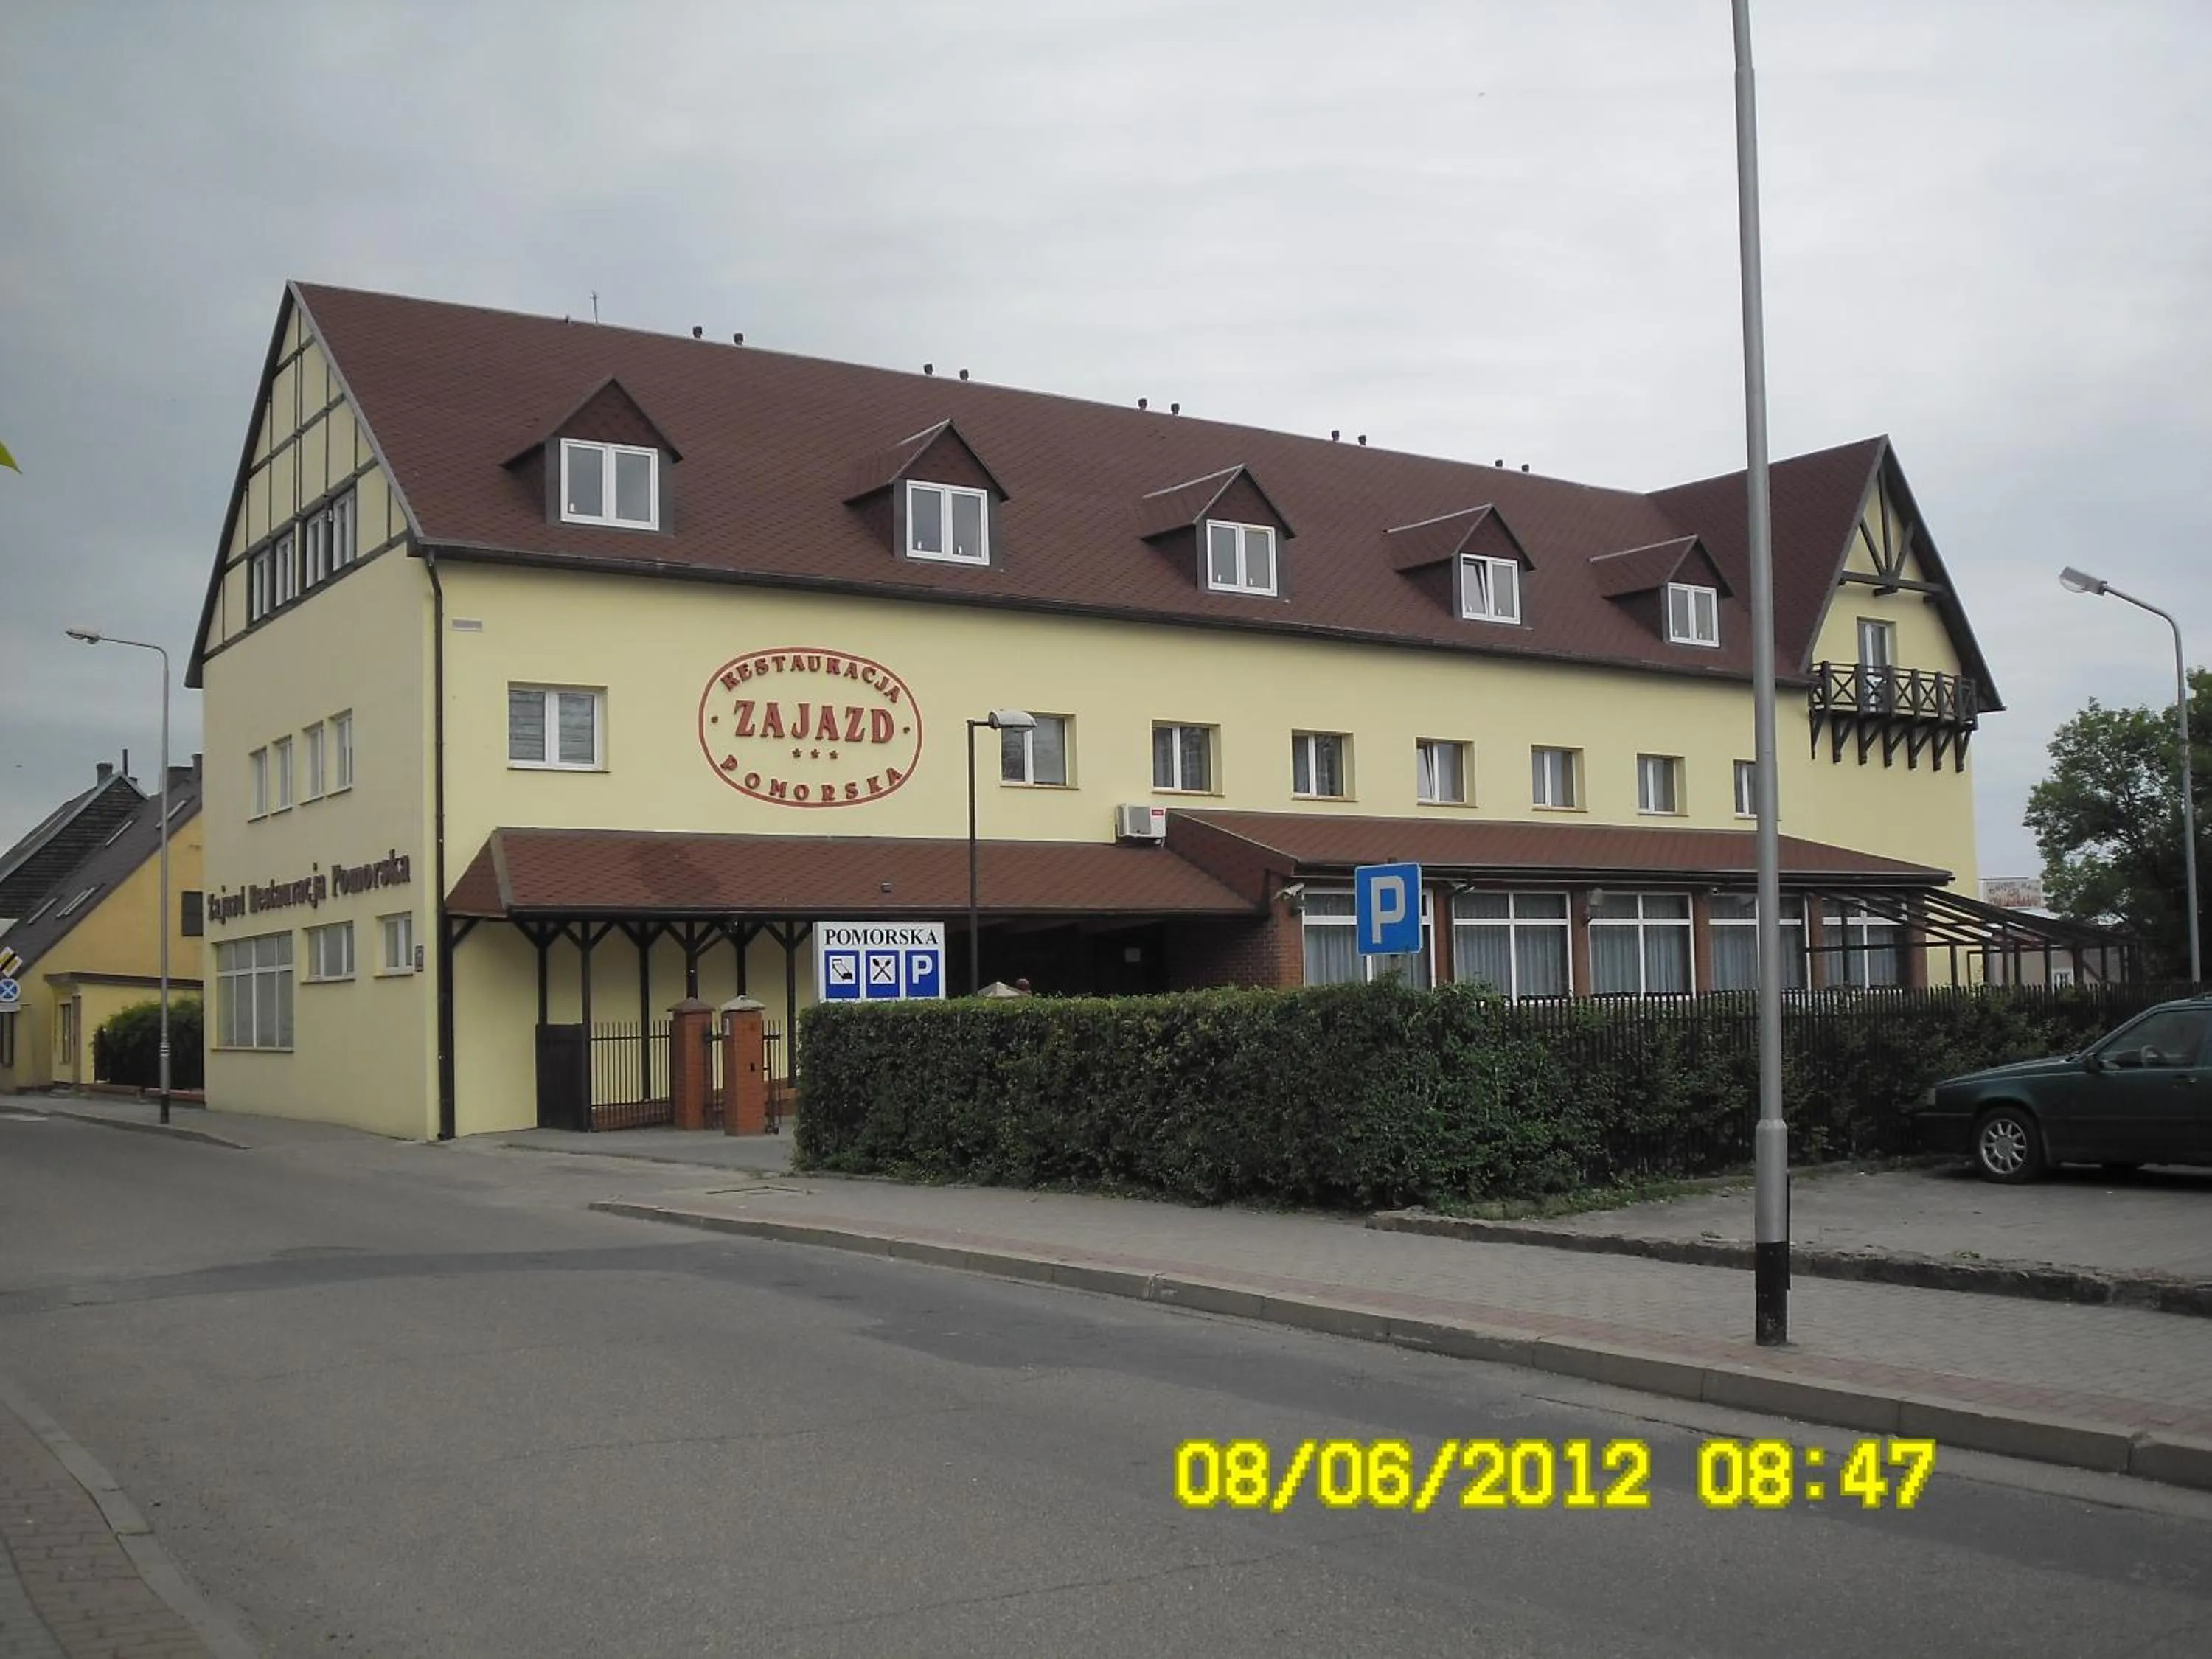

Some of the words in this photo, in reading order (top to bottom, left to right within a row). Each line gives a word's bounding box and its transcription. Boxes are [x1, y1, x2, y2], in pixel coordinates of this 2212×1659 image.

[720, 655, 901, 703] RESTAURACJA
[733, 700, 894, 743] ZAJAZD
[720, 754, 902, 801] POMORSKA
[331, 849, 411, 897] Pomorska
[1371, 875, 1406, 945] P
[824, 928, 939, 945] POMORSKA
[911, 954, 933, 984] P
